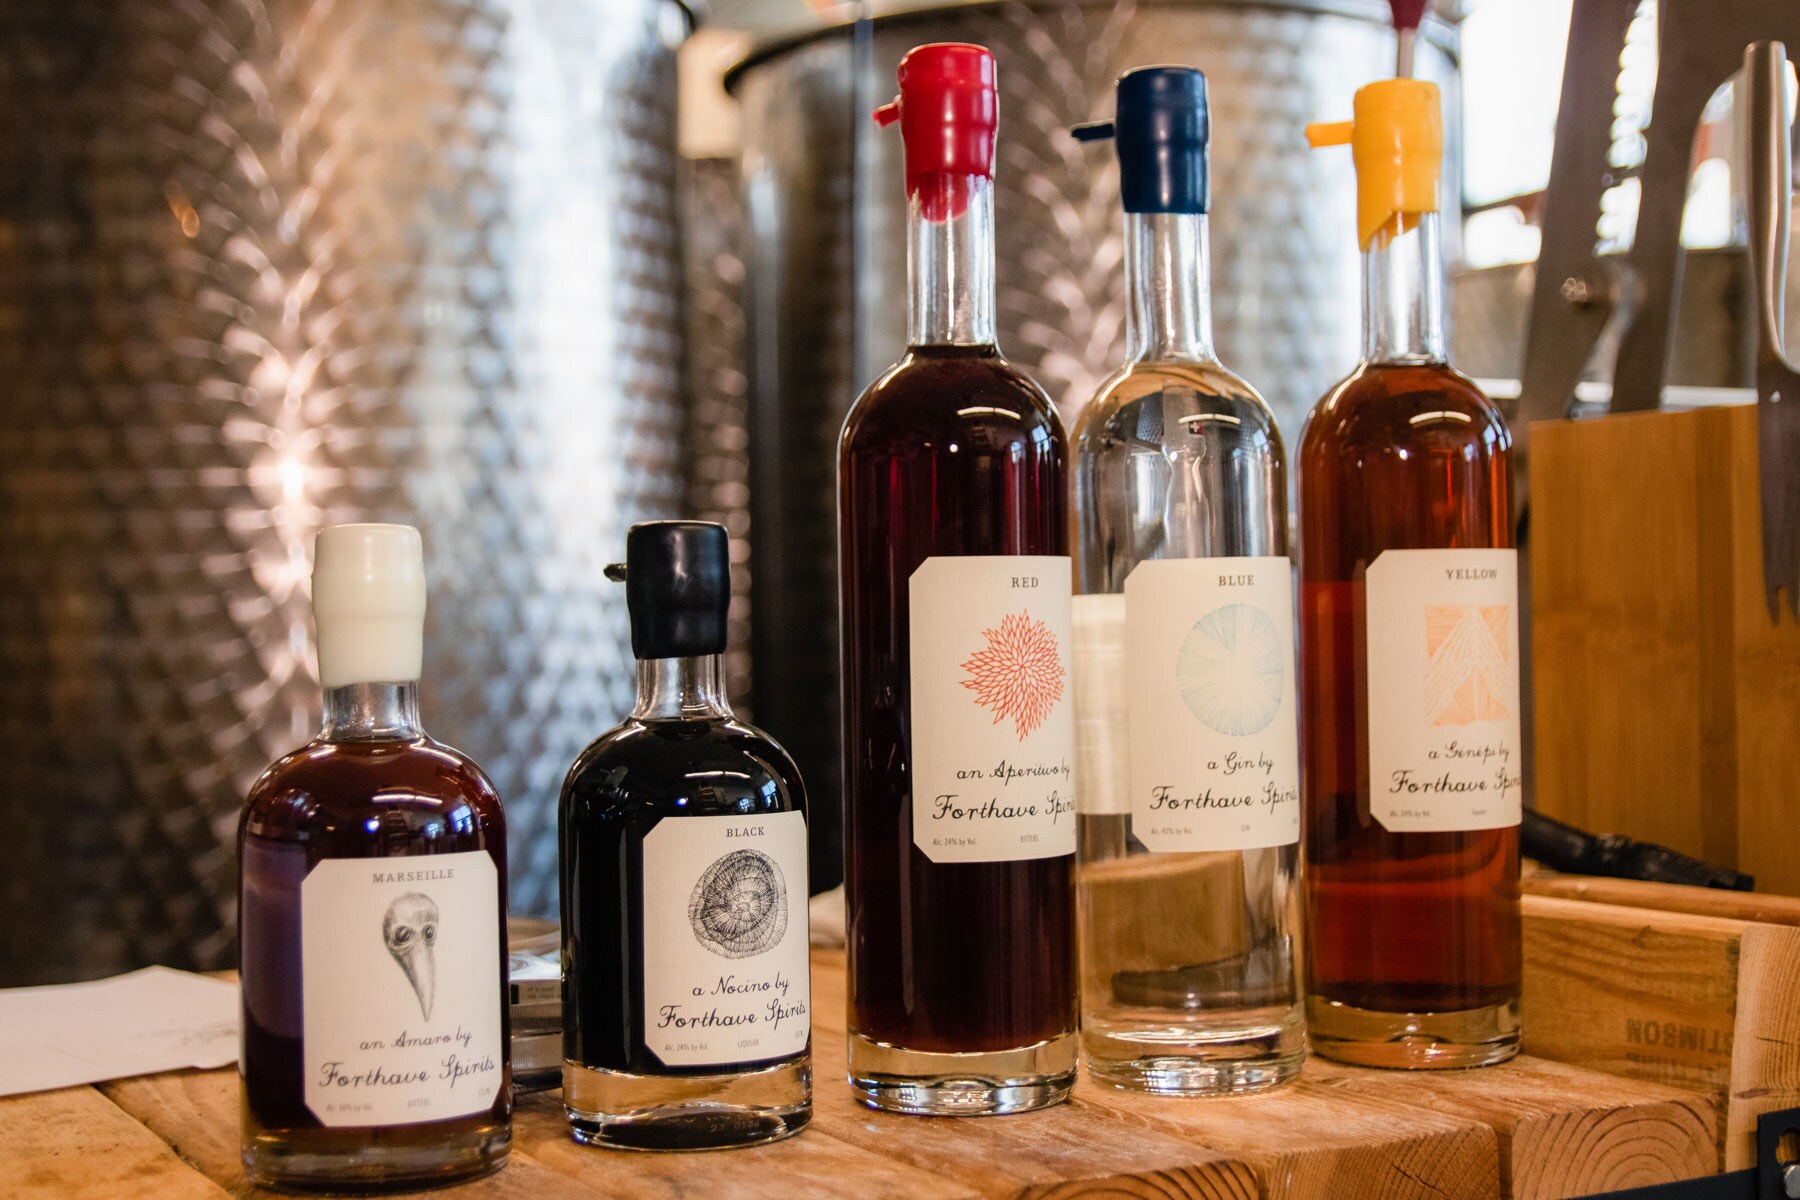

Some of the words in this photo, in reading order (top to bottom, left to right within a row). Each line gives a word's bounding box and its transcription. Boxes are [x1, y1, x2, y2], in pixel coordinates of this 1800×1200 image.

[1011, 576, 1039, 588] RED
[1218, 574, 1255, 586] BLUE
[1446, 567, 1497, 580] YELLOW
[1207, 761, 1219, 770] a
[1223, 751, 1255, 775] Gin
[1258, 750, 1274, 775] by
[1428, 751, 1439, 759] a
[1498, 739, 1509, 763] by
[956, 769, 984, 779] an
[989, 759, 1059, 786] Aperitivo
[1061, 756, 1070, 781] by
[1389, 769, 1489, 794] Forthave
[932, 794, 1038, 820] Forthave
[1150, 785, 1254, 810] Forthave
[726, 827, 765, 838] BLACK
[372, 868, 455, 883] MARSEILLE
[692, 986, 704, 996] a
[711, 975, 771, 995] Nocino
[774, 971, 790, 996] by
[657, 1004, 758, 1028] Forthave
[765, 998, 806, 1030] Spirits
[360, 1040, 385, 1050] an
[390, 1030, 451, 1048] Amaro
[456, 1024, 472, 1048] by
[319, 1061, 431, 1087] Forthave
[439, 1054, 495, 1088] Spirits
